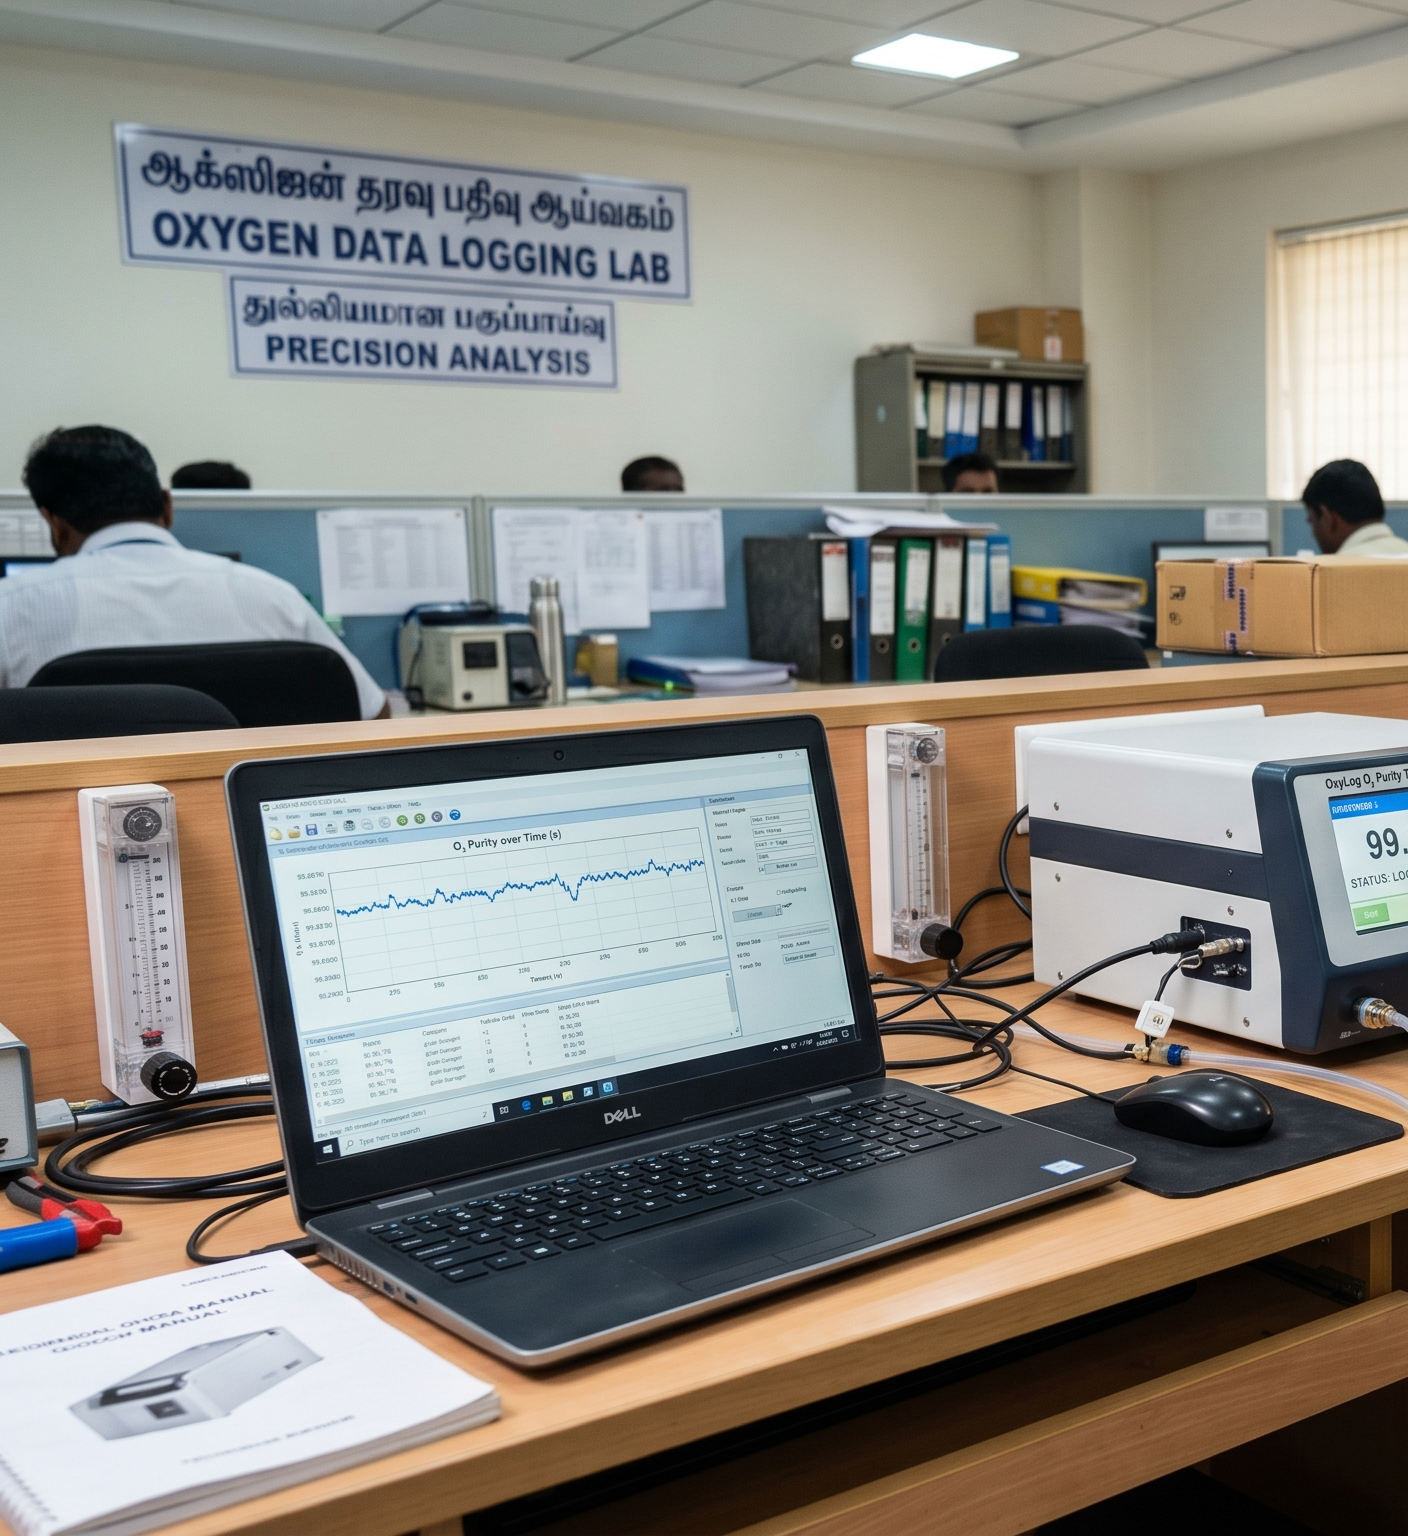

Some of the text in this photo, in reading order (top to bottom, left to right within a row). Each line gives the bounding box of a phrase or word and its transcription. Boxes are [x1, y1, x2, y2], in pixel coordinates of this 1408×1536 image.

[141, 148, 675, 232] ஆக்ஸிஜன் தரவு பதிவு ஆய்வகம்
[153, 210, 671, 285] OXYGEN DATA LOGGING LAB
[265, 333, 592, 377] PRECISION ANALYSIS
[1325, 776, 1362, 791] OxyLog
[1376, 770, 1402, 783] Purity
[468, 838, 498, 849] Purity
[500, 835, 521, 845] over
[523, 832, 547, 842] Time
[549, 829, 562, 841] (s)
[1350, 873, 1391, 889] STATUS:
[603, 1106, 641, 1125] DELL
[188, 1288, 275, 1312] MANUAL
[139, 1309, 228, 1333] MANUAL
